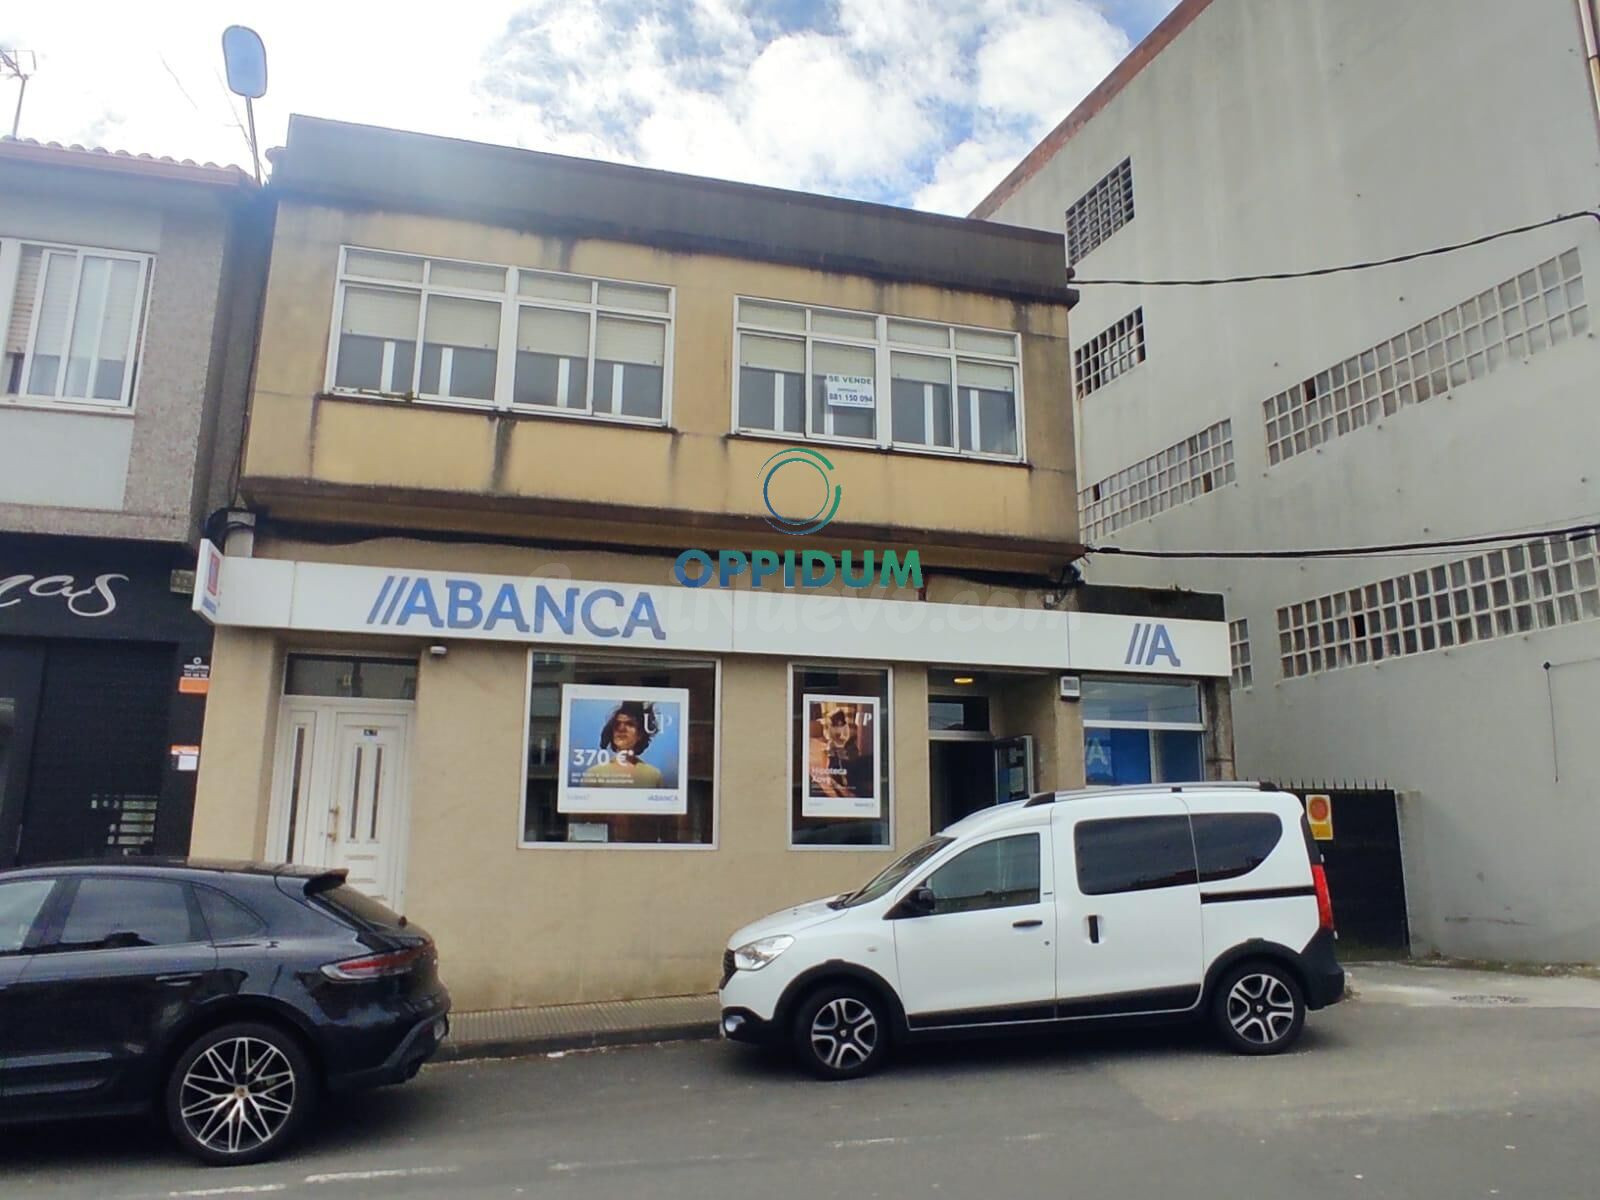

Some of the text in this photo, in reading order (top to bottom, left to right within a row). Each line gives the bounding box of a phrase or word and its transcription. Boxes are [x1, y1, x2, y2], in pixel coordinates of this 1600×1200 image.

[842, 376, 871, 384] VENDE
[829, 392, 841, 400] 881
[396, 577, 666, 640] ABANCA
[573, 749, 609, 765] 370
